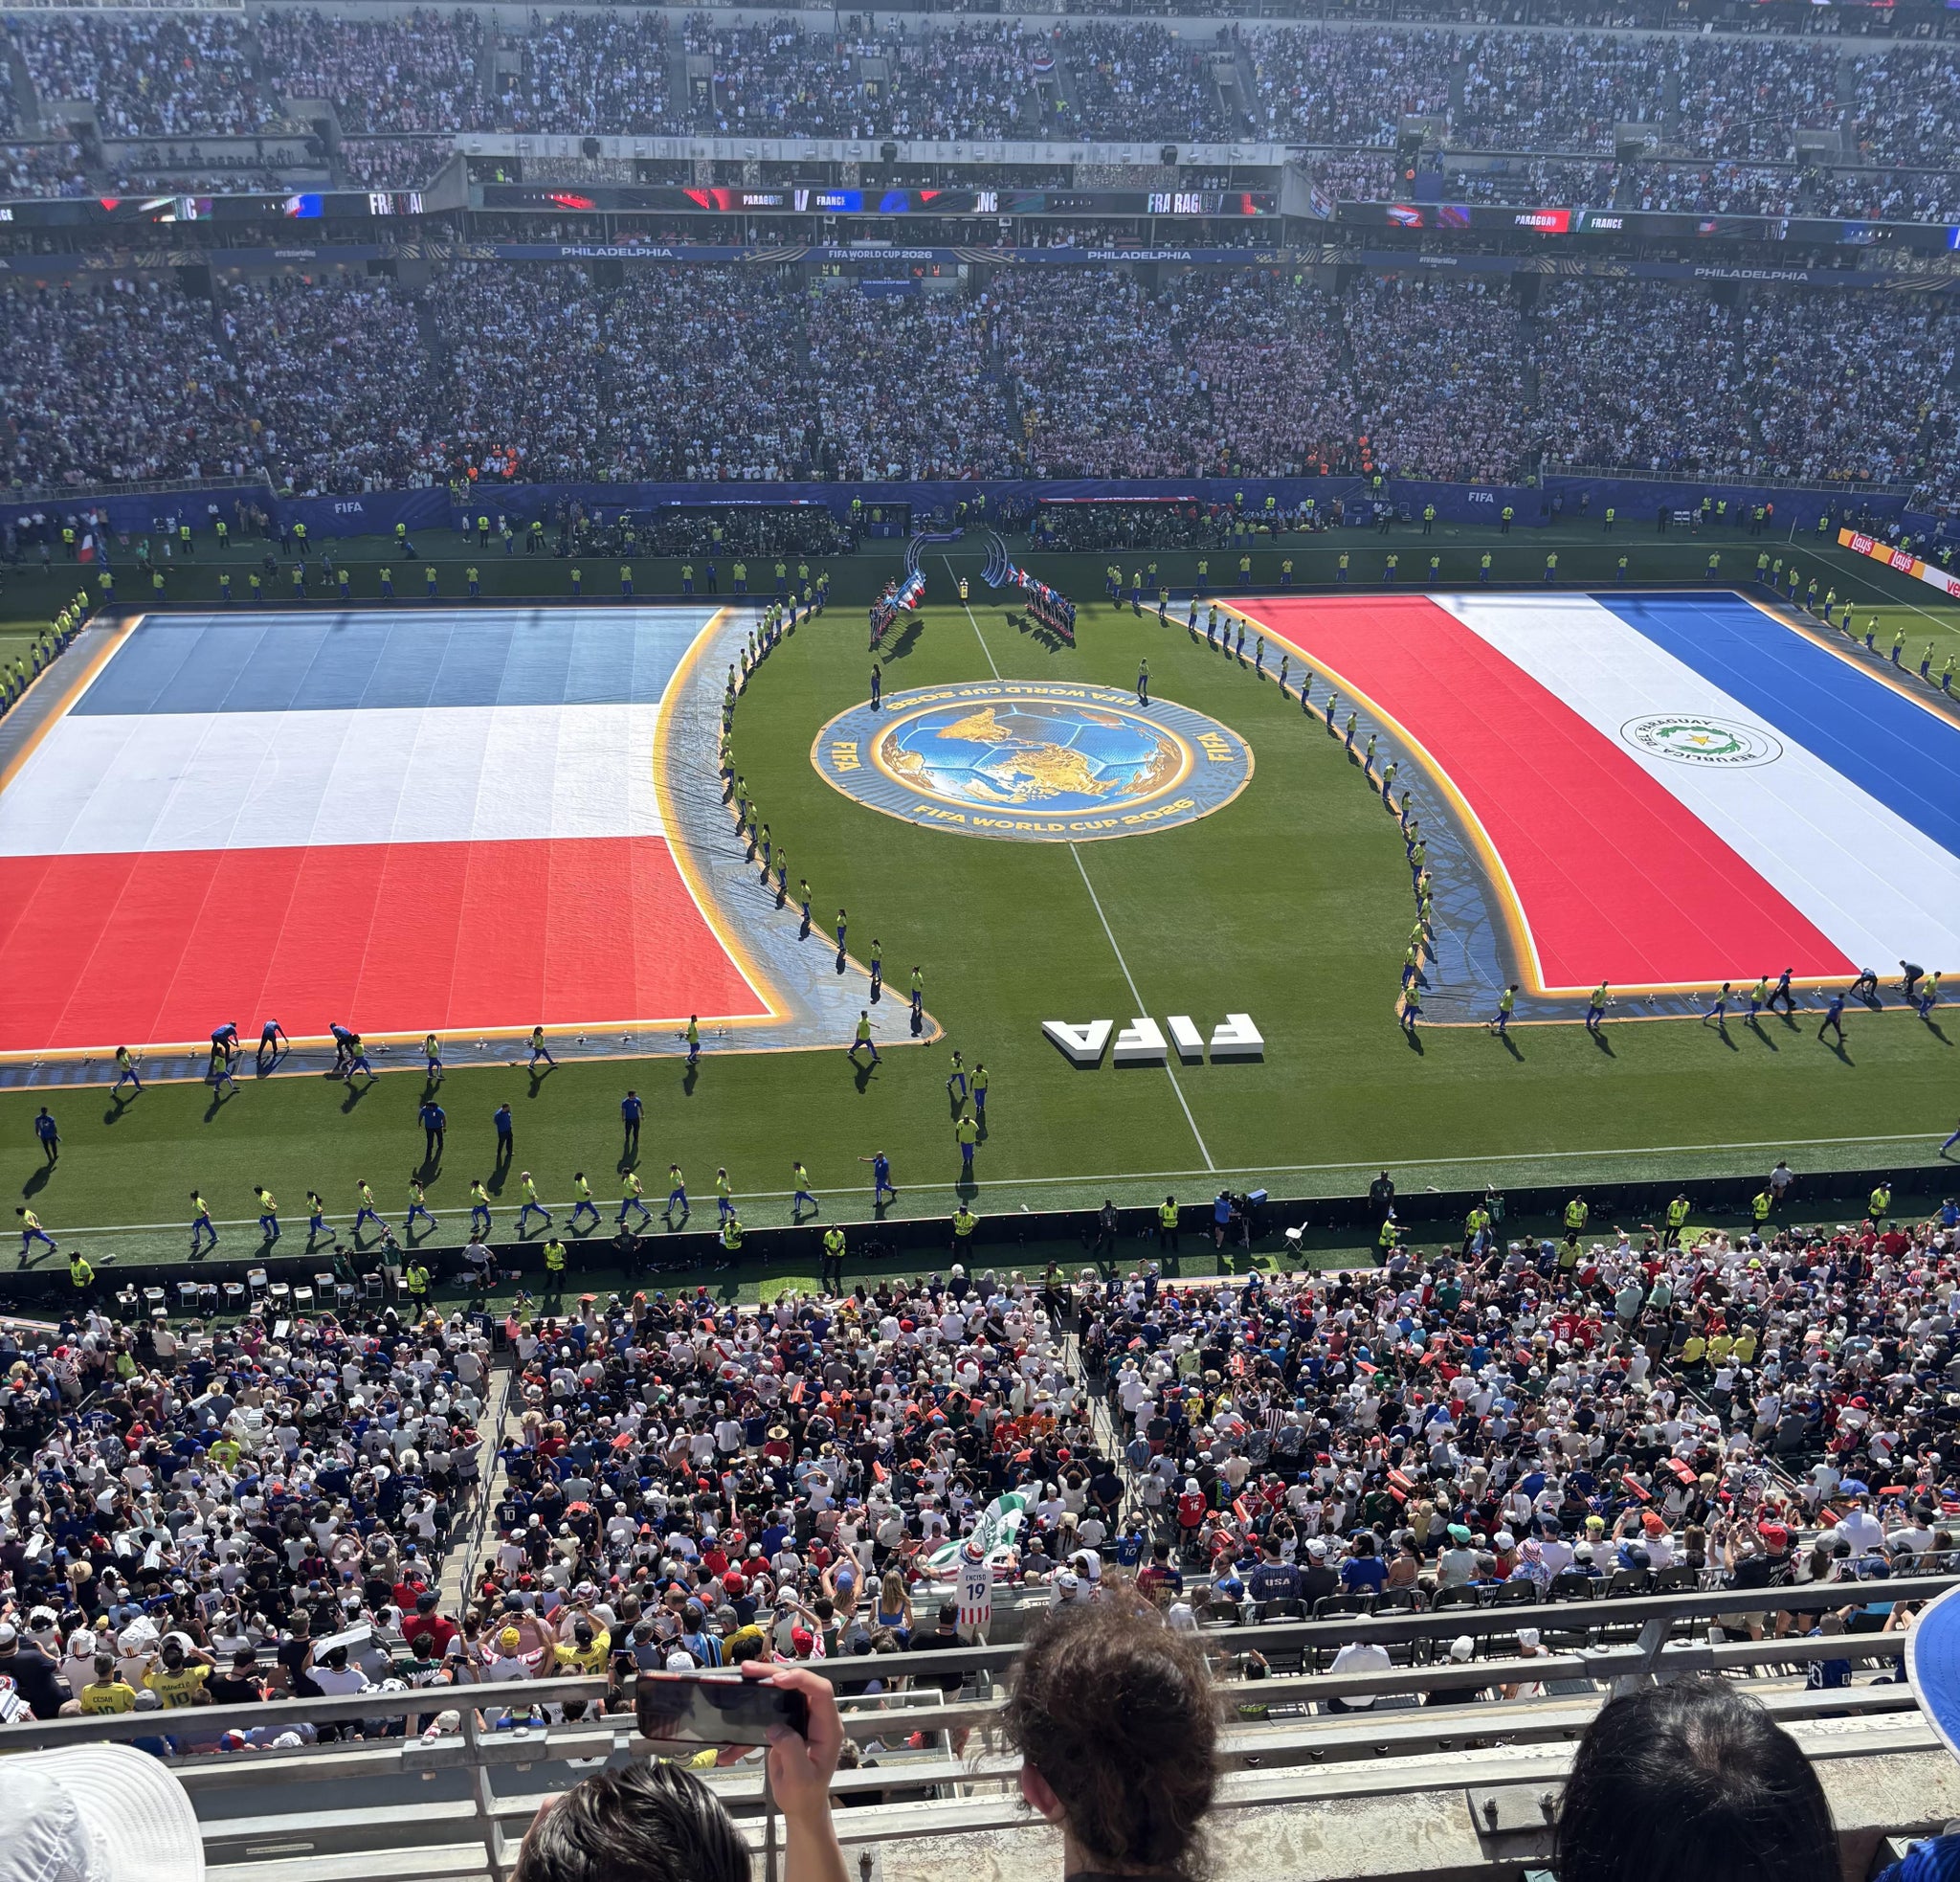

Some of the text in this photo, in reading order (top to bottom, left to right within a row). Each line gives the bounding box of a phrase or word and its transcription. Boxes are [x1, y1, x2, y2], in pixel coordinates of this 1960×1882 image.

[1592, 217, 1623, 229] FRANCE
[562, 247, 673, 258] PHILADELPHIA
[829, 250, 933, 259] FIFA WORLD CUP 2026
[1087, 251, 1192, 260] PHILADELPHIA
[1694, 267, 1809, 281] PHILADELPHIA
[1468, 491, 1494, 504] FIFA
[334, 502, 364, 514] FIFA
[1851, 533, 1872, 553] Lay's
[1891, 550, 1912, 571] Lay's
[959, 686, 1002, 697] CUP
[1006, 686, 1085, 698] WORLD
[1638, 717, 1713, 732] PARAGUAY
[1195, 730, 1235, 763] FIFA
[833, 741, 863, 773] FIFA
[912, 796, 1196, 833] FIFA WORLD CUP 2026
[1041, 1013, 1265, 1062] FIFA
[917, 1308, 927, 1317] 10
[1559, 1327, 1570, 1338] 88
[417, 1369, 425, 1379] 5
[277, 1384, 288, 1396] 10
[1771, 1401, 1779, 1413] 7
[90, 1420, 103, 1432] 10
[179, 1417, 188, 1430] 7
[370, 1443, 379, 1453] 6
[44, 1478, 53, 1490] 6
[1190, 1500, 1200, 1512] 16
[1246, 1504, 1256, 1514] 7
[502, 1510, 516, 1521] 10
[1303, 1511, 1318, 1523] 67
[1125, 1547, 1137, 1557] 10
[1264, 1578, 1290, 1587] USA
[966, 1582, 986, 1602] 19
[205, 1600, 218, 1613] 10
[168, 1691, 190, 1708] 10
